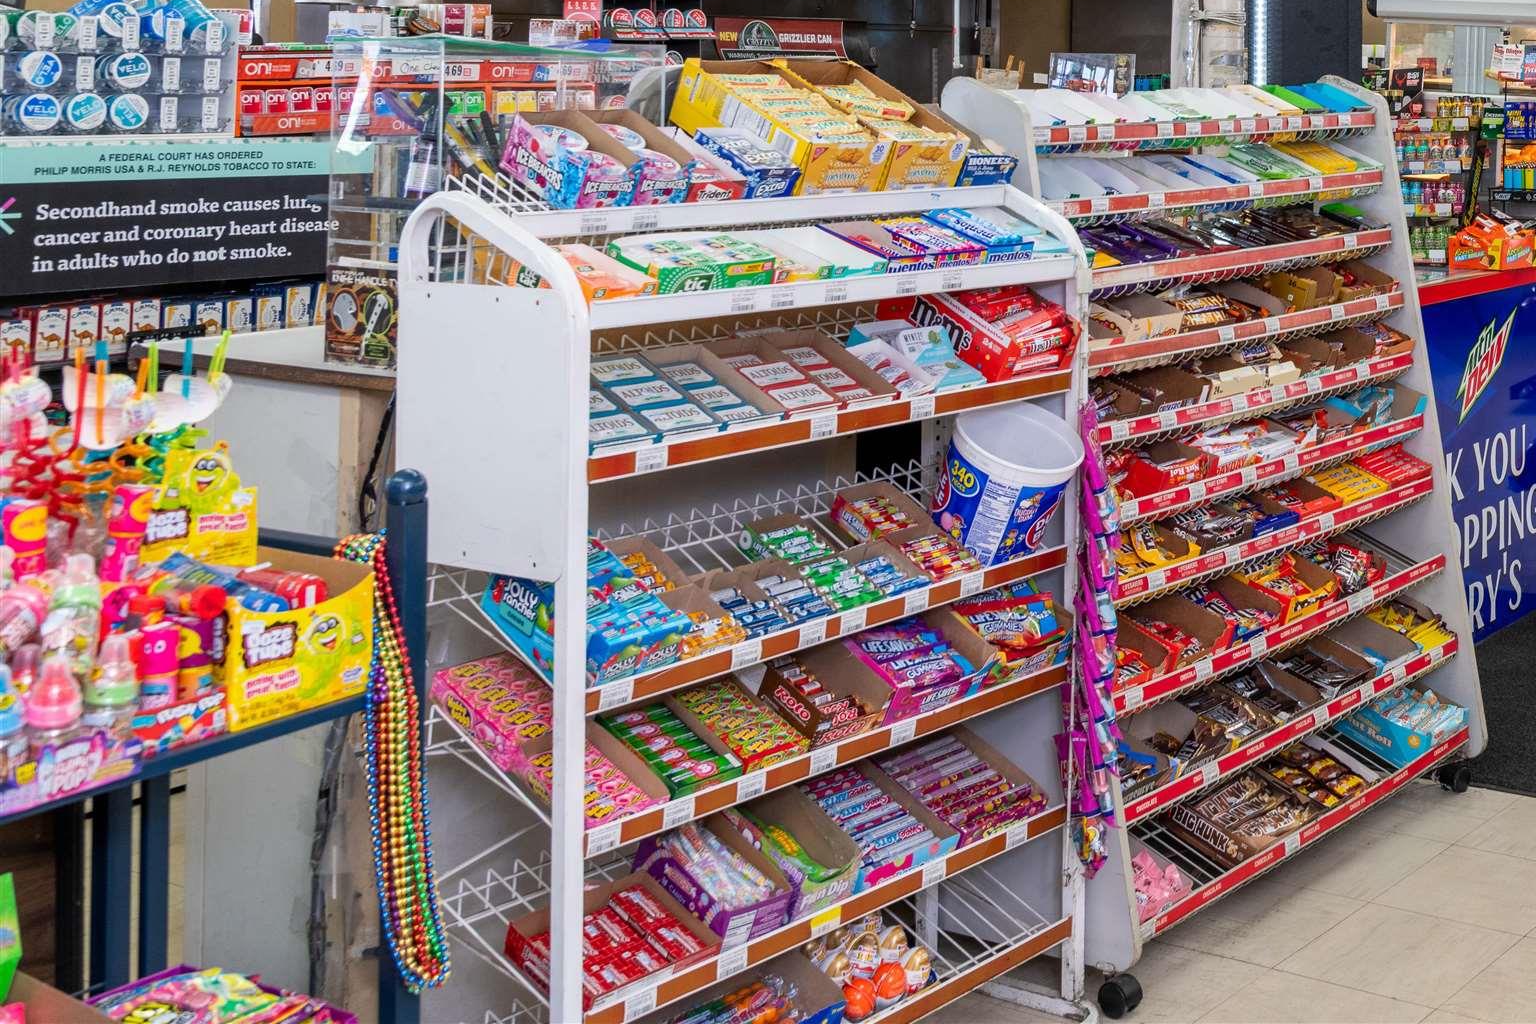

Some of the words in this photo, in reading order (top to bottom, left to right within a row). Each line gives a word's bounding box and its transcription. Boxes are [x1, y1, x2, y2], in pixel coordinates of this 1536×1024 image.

[720, 32, 738, 41] NEW
[779, 33, 816, 44] GRIZZLIER
[817, 34, 832, 44] CAN
[119, 63, 147, 74] VELO
[109, 153, 155, 161] FEDERAL
[158, 152, 191, 160] COURT
[195, 152, 214, 160] HAS
[217, 151, 263, 159] ORDERED
[34, 167, 68, 175] PHILIP
[71, 166, 111, 174] MORRIS
[114, 165, 135, 174] USA
[137, 165, 144, 173] &
[147, 164, 164, 172] R.J.
[168, 162, 221, 172] REYNOLDS
[224, 162, 269, 171] TOBACCO
[272, 162, 284, 170] TO
[287, 160, 316, 169] STATE:
[583, 182, 598, 194] ICE
[598, 180, 634, 193] BREAKERS
[755, 181, 786, 196] Extra
[697, 189, 732, 201] Trident
[36, 200, 156, 221] Secondhand
[160, 199, 220, 215] smoke
[223, 198, 280, 212] causes
[33, 232, 100, 246] cancer
[104, 226, 140, 242] and
[144, 224, 225, 241] coronary
[229, 221, 276, 236] heart
[279, 218, 339, 233] disease
[32, 256, 54, 272] in
[58, 253, 118, 271] adults
[122, 252, 162, 267] who
[167, 249, 189, 264] do
[192, 247, 227, 262] not
[230, 244, 292, 259] smoke.
[988, 251, 1030, 263] mentos
[684, 278, 704, 291] tic
[39, 311, 66, 322] CAMEL
[750, 363, 799, 379] ALTOIDS
[777, 388, 828, 402] ALTOIDS
[1447, 448, 1464, 504] K
[1473, 424, 1526, 492] YOU
[951, 460, 975, 486] 340
[504, 578, 539, 609] JOLLY
[1469, 550, 1522, 632] RY'S
[984, 621, 1024, 633] GUMMIES
[1173, 805, 1197, 832] BIG
[1194, 820, 1229, 852] HUNK
